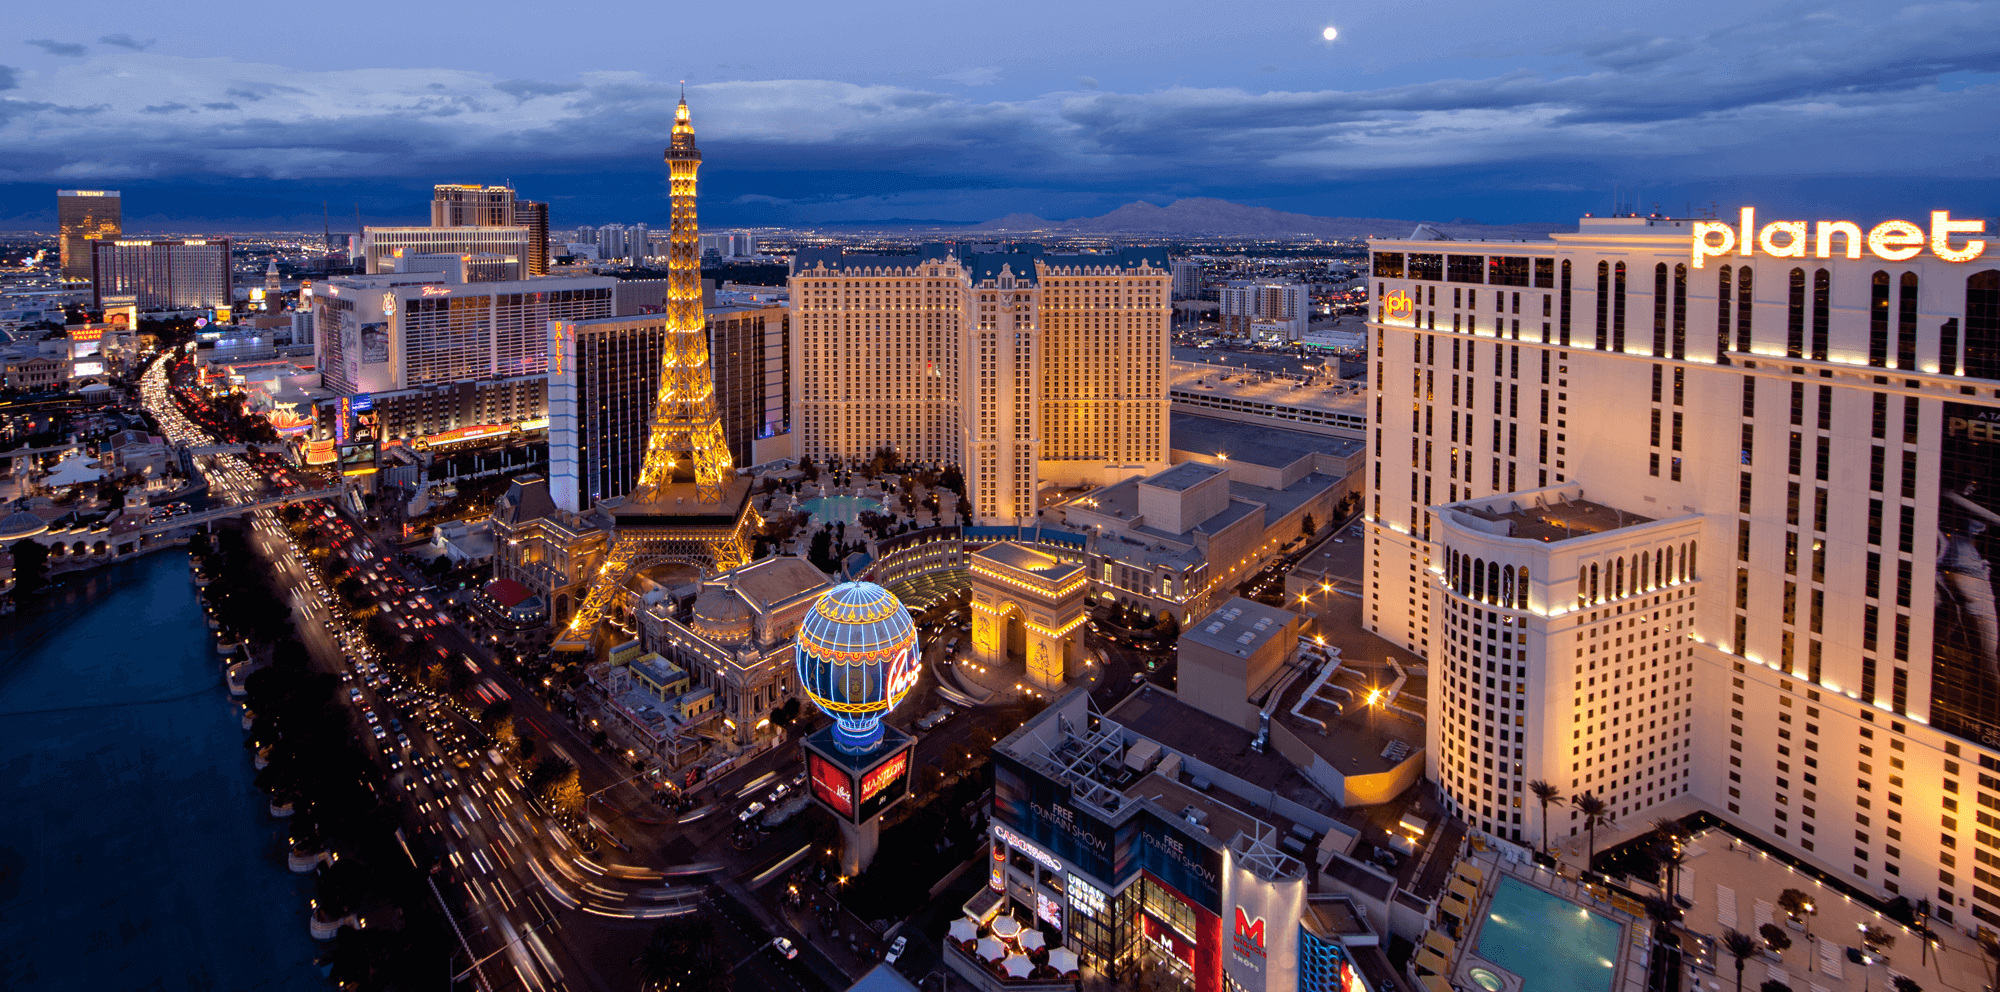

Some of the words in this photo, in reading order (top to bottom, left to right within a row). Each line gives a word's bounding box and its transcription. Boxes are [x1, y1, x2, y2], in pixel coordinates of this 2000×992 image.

[1692, 206, 1986, 269] planet
[422, 286, 451, 296] Flamingo
[1388, 290, 1412, 314] ph
[1978, 412, 1987, 420] A
[1960, 717, 1981, 732] THE
[863, 759, 905, 795] MANILOW
[1052, 803, 1074, 823] FREE
[1030, 802, 1071, 832] FOUNTAIN
[1072, 825, 1106, 851] SHOW
[1163, 834, 1184, 854] FREE
[1143, 831, 1180, 862] FOUNTAIN
[1182, 856, 1215, 883] SHOW
[1068, 873, 1105, 902] URBAN
[1068, 895, 1094, 917] TERS
[1235, 904, 1266, 948] M
[1161, 934, 1173, 951] M
[1233, 934, 1267, 958] MIRACLE
[1233, 943, 1250, 958] MILE
[1232, 952, 1259, 972] SHOPS
